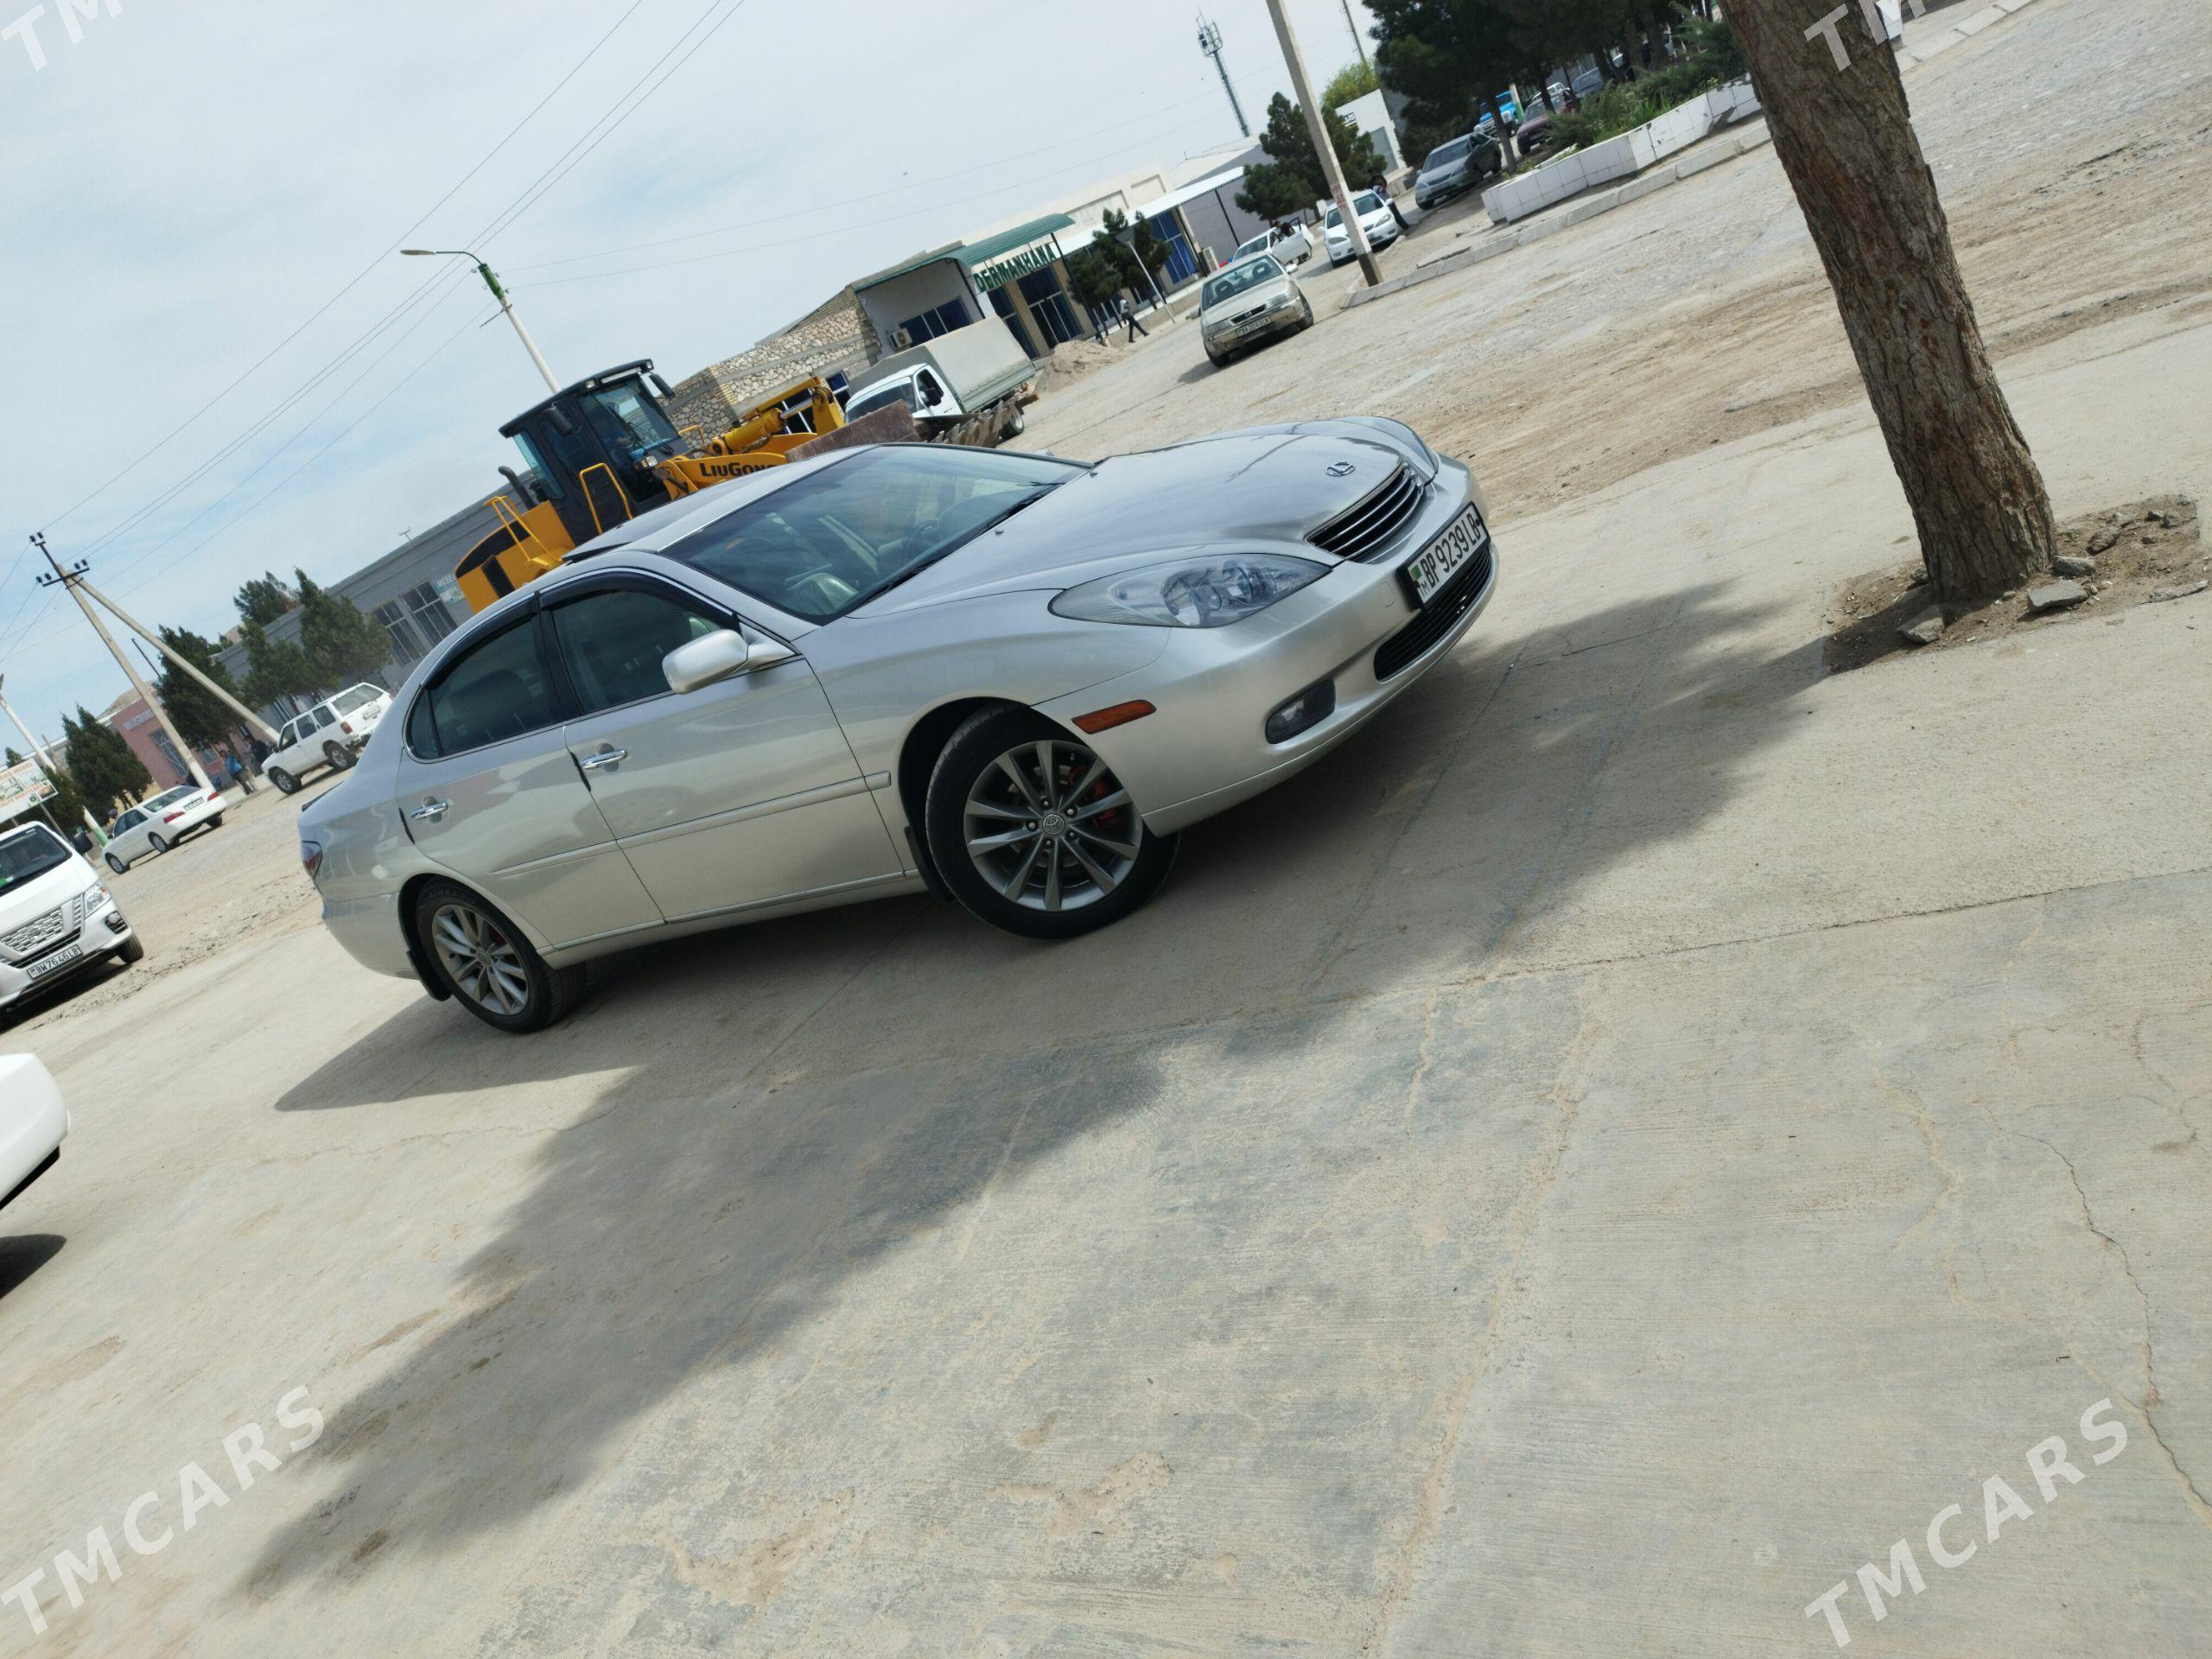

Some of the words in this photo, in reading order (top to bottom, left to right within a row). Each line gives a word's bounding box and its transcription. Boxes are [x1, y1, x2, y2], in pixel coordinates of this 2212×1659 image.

[972, 243, 1057, 293] DERMANHANA
[1420, 552, 1440, 588] BP
[1435, 524, 1470, 573] 9239
[1462, 512, 1481, 547] LB
